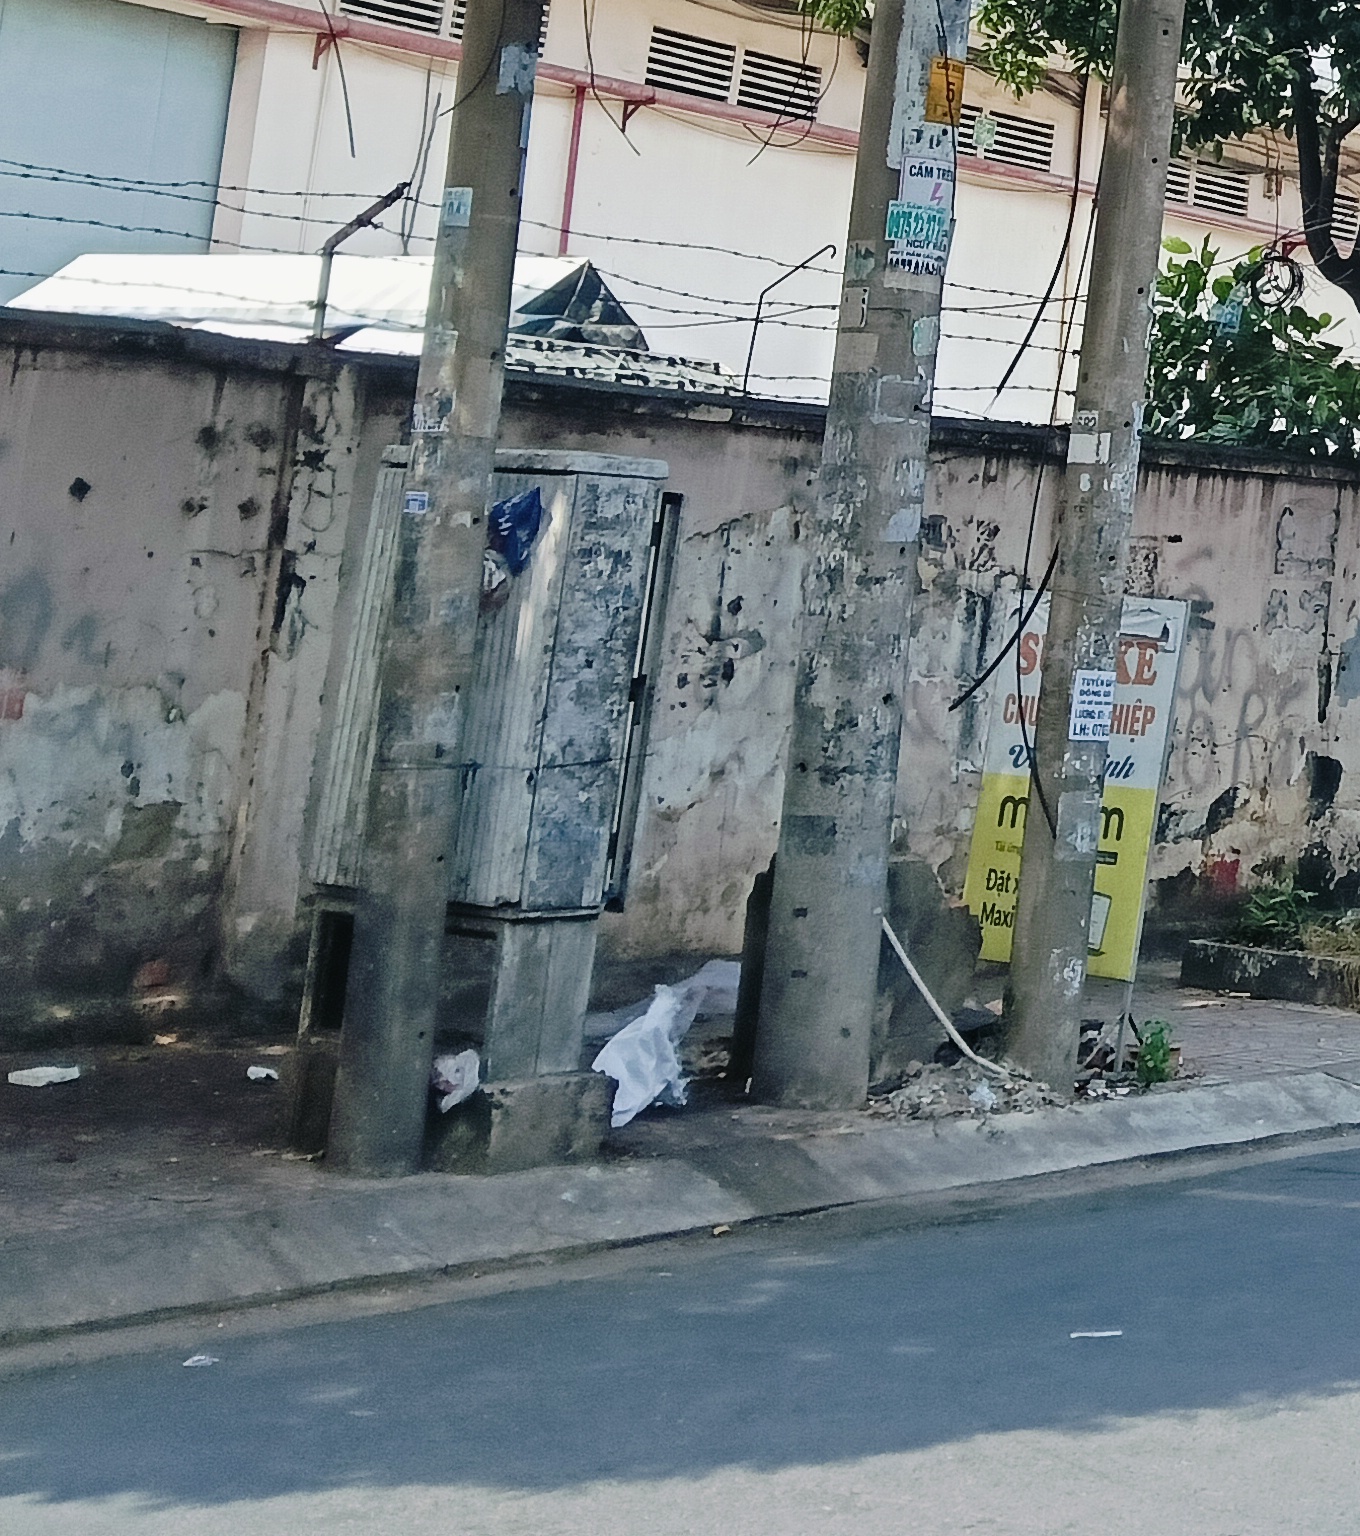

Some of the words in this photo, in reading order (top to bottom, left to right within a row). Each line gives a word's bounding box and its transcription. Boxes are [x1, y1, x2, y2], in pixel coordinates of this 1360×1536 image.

[909, 161, 934, 179] CẤM
[1110, 698, 1156, 742] HIỆP
[985, 868, 1011, 897] Đặt
